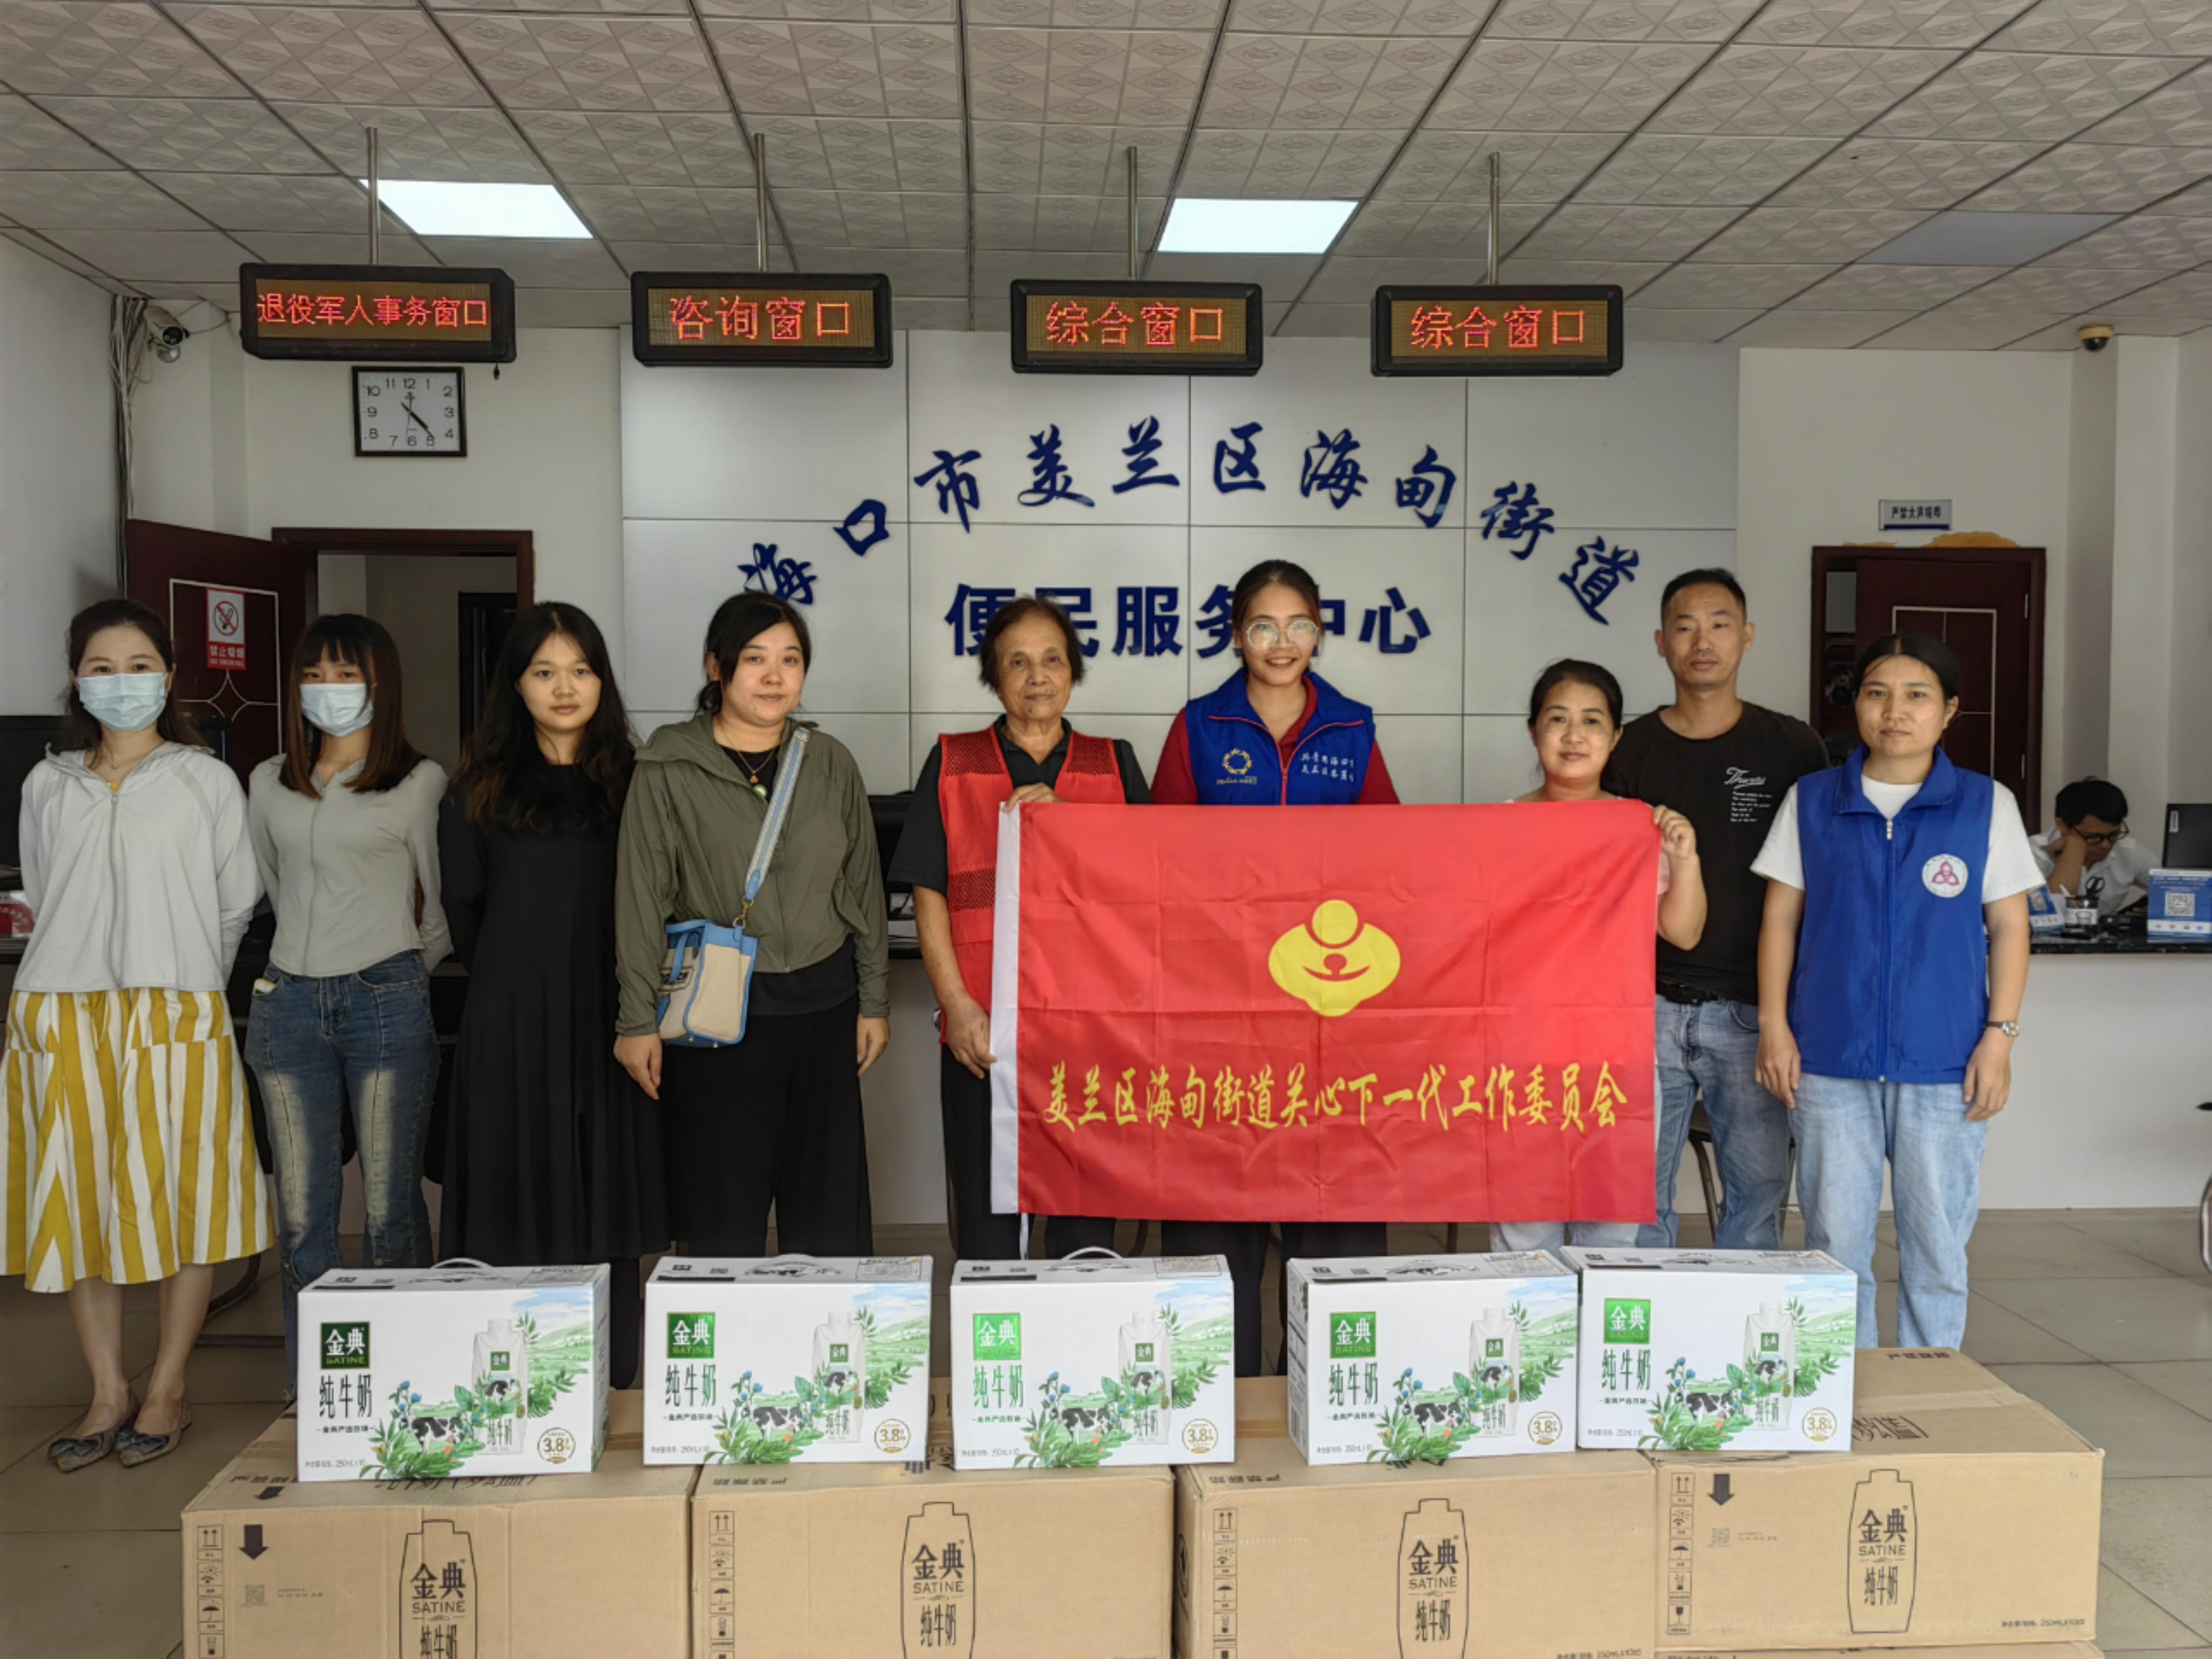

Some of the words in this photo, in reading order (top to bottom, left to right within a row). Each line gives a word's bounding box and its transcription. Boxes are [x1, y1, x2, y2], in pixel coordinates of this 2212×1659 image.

[257, 293, 488, 328] 退役军人事务窗口
[670, 295, 850, 341] 咨询窗口
[1046, 301, 1224, 347] 综合窗口
[1410, 305, 1585, 350] 综合窗口
[366, 385, 381, 397] 10
[385, 378, 396, 389] 11
[403, 378, 416, 389] 12
[443, 385, 453, 397] 2
[367, 406, 377, 417] 9
[444, 406, 454, 419] 3
[369, 428, 379, 440] 8
[389, 435, 398, 446] 7
[407, 435, 417, 447] 6
[445, 428, 454, 439] 4
[737, 416, 1640, 624] 海口市美兰区海甸街道
[1043, 1060, 1628, 1132] 美兰区海甸街道关心下一代工作委员会
[672, 1318, 711, 1345] 金典
[1335, 1317, 1372, 1345] 金典
[1609, 1305, 1645, 1331] 金典
[324, 1328, 366, 1356] 金典
[978, 1319, 1016, 1347] 金典
[1602, 1348, 1651, 1391] 纯牛奶
[319, 1373, 372, 1419] 纯牛奶
[665, 1364, 716, 1407] 纯牛奶
[973, 1365, 1023, 1409] 纯牛奶
[1329, 1362, 1378, 1406] 纯牛奶
[880, 1429, 899, 1442] 3.8
[1188, 1428, 1206, 1444] 3.8
[1533, 1420, 1553, 1435] 3.8
[1807, 1416, 1827, 1431] 3.8
[543, 1437, 564, 1452] 3.8
[1857, 1508, 1908, 1543] 金典
[911, 1542, 965, 1580] 金典
[1407, 1538, 1459, 1576] 金典
[1859, 1544, 1907, 1556] SATINE
[409, 1561, 466, 1600] 金典
[913, 1581, 964, 1594] SATINE
[1408, 1576, 1458, 1589] SATINE
[1864, 1565, 1898, 1606] 纯牛奶
[412, 1600, 466, 1614] SATINE
[1415, 1599, 1450, 1642] 纯牛奶
[921, 1603, 956, 1647] 纯牛奶
